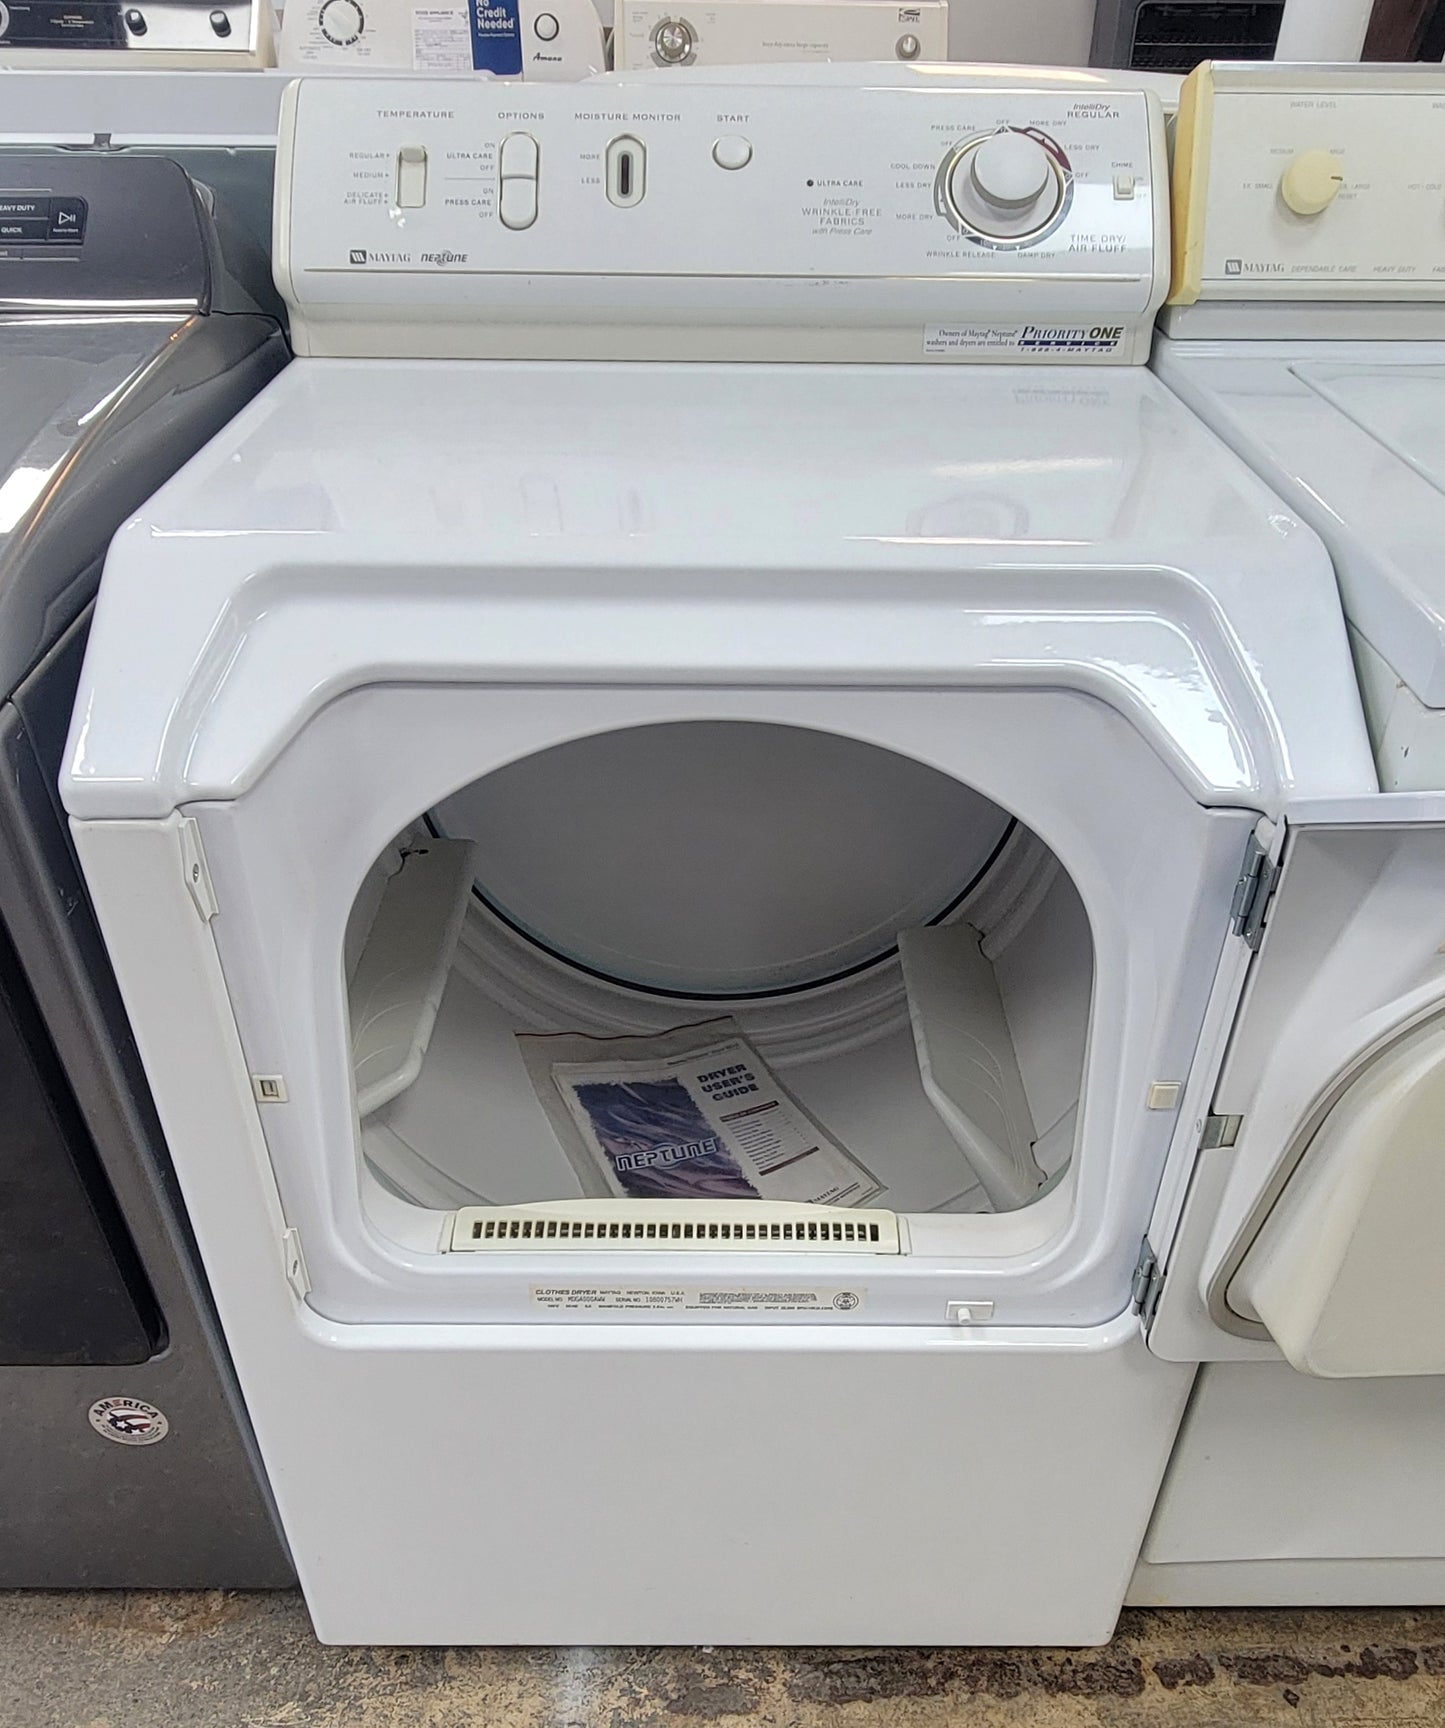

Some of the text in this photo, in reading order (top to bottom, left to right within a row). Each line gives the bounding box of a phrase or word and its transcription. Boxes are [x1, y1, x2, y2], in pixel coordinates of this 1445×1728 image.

[476, 7, 506, 18] Credit
[477, 18, 514, 29] Needed
[376, 110, 454, 119] TEMPERATURE
[498, 112, 545, 120] OPTIONS
[574, 113, 628, 121] MOISTURE
[819, 217, 865, 226] FABRICS
[853, 228, 872, 236] Care
[1070, 234, 1096, 243] TIME
[1068, 244, 1127, 253] AIR FLUFF
[368, 253, 411, 263] MAYTAG
[1244, 263, 1285, 273] MAYTAG
[1021, 326, 1124, 339] PRIORITY ONE
[696, 1064, 747, 1083] DRYER
[701, 1073, 756, 1093] USER'S
[712, 1083, 760, 1102] GUIDE
[616, 1139, 718, 1171] NEPTUNE
[93, 1399, 159, 1418] AMERICA
